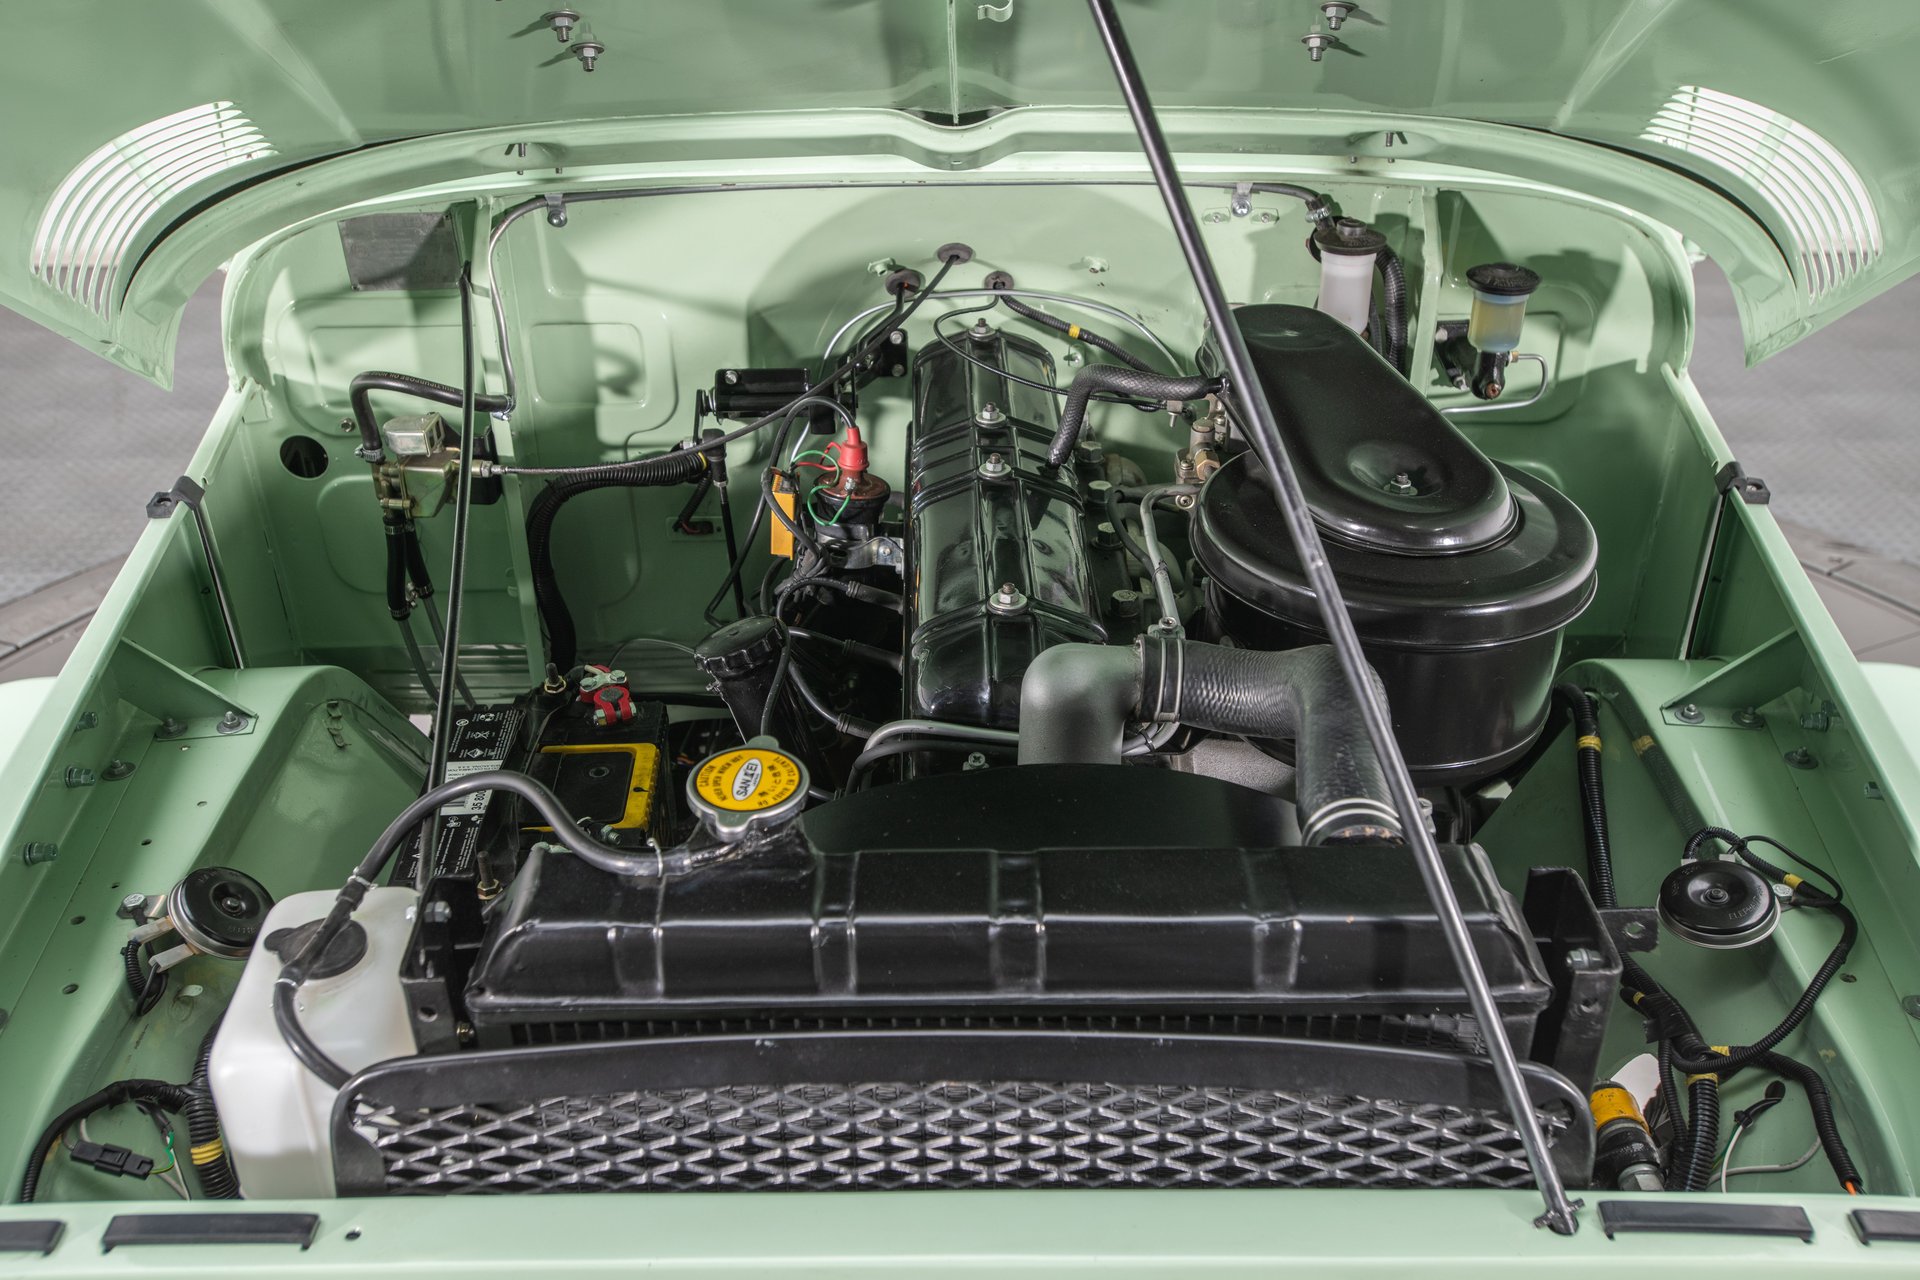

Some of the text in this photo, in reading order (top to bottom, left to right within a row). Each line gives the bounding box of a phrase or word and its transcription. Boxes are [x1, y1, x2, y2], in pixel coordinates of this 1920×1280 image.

[698, 764, 716, 788] CAUTION
[712, 775, 723, 787] OPEN
[718, 762, 732, 775] WHEN
[731, 755, 743, 764] HOT
[736, 762, 758, 797] SANKEI
[471, 802, 483, 810] 35
